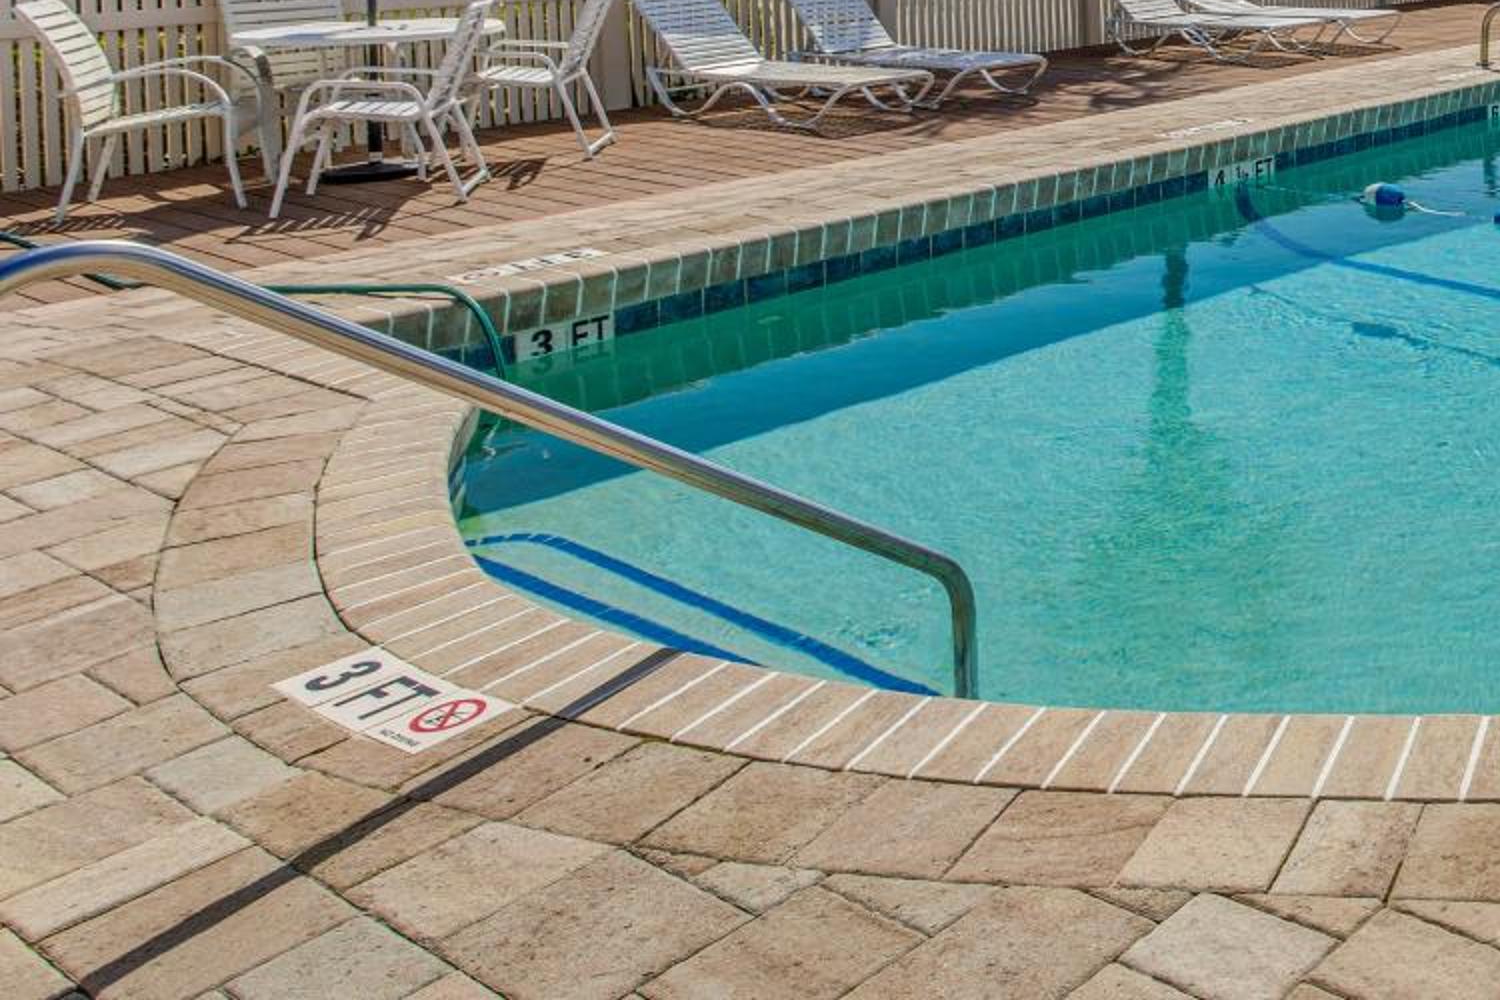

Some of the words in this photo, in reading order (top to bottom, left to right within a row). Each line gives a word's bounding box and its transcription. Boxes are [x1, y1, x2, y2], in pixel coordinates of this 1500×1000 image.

[1255, 157, 1273, 184] FT
[531, 329, 554, 357] 3
[571, 315, 609, 347] FT
[304, 660, 383, 691] 3
[333, 675, 442, 721] FT
